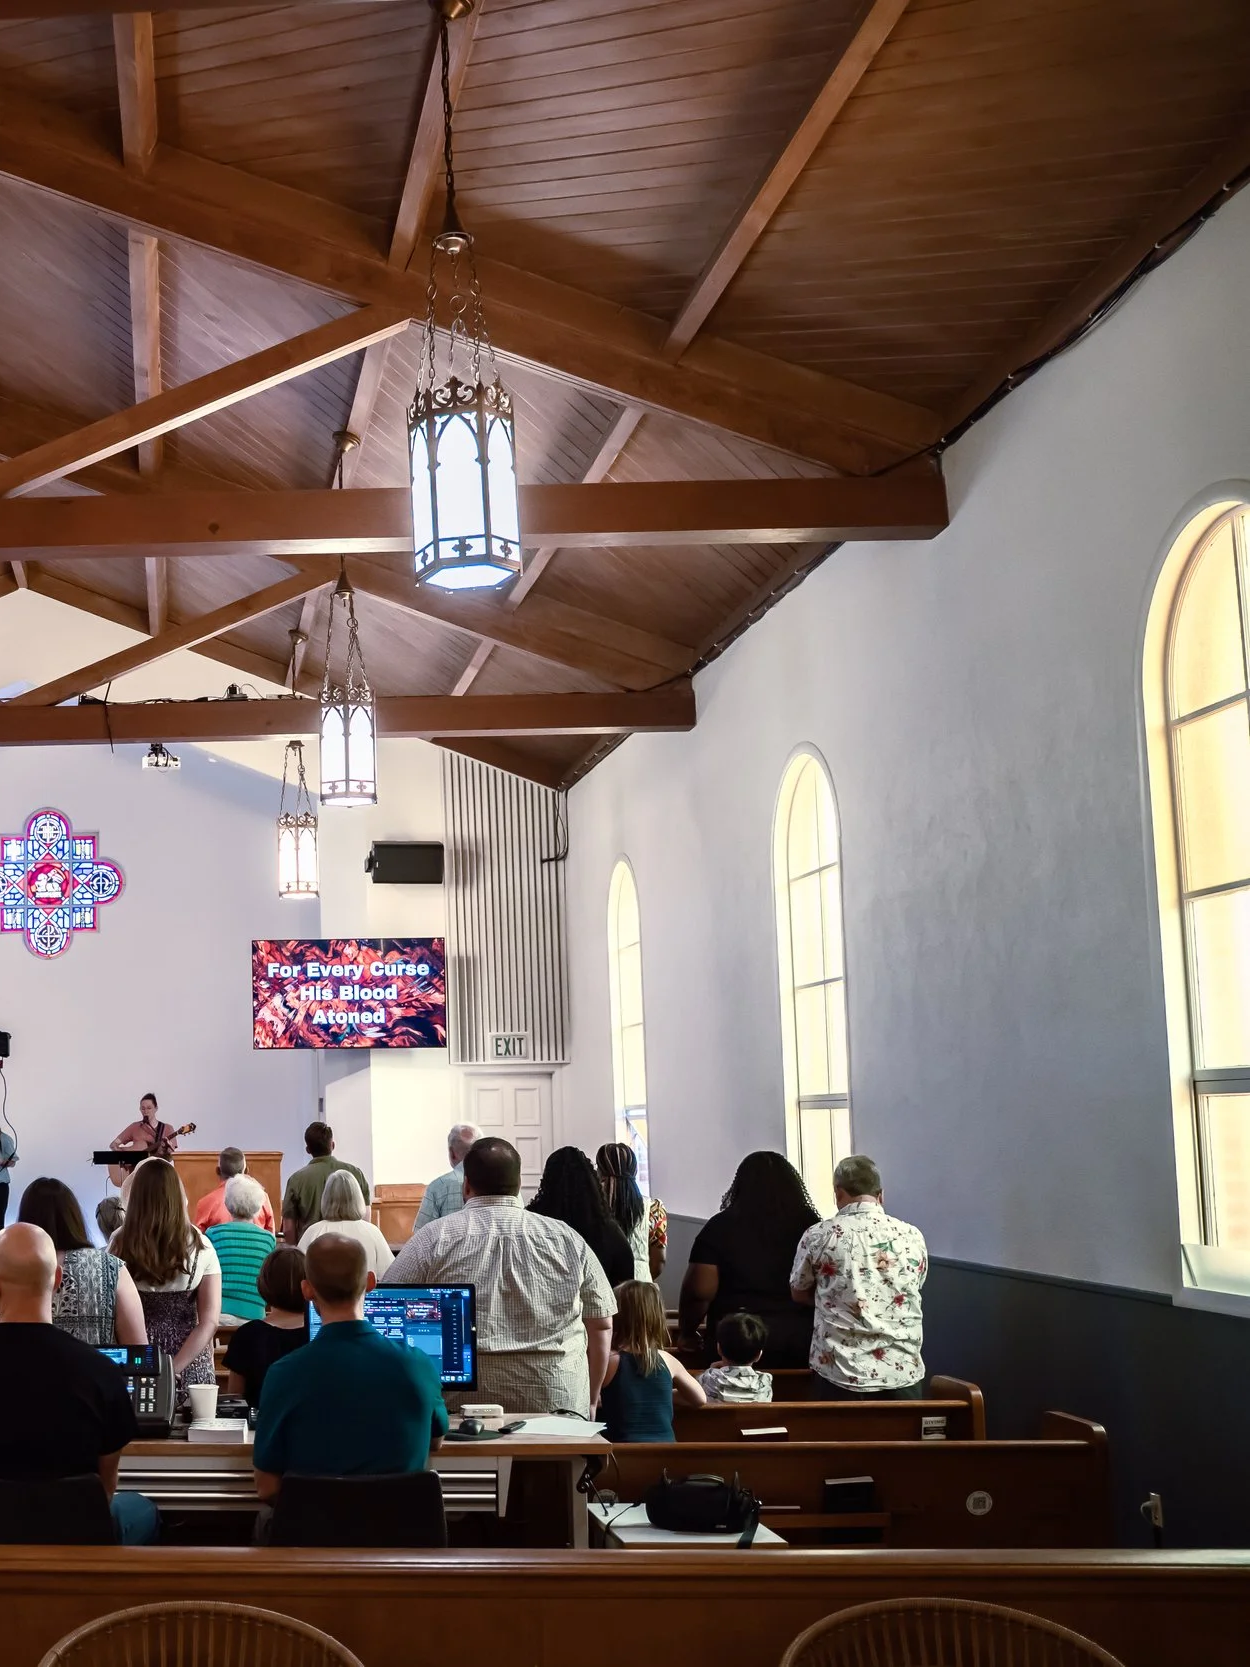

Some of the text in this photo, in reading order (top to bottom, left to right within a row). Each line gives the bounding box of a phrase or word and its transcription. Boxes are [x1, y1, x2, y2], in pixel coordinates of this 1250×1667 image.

[267, 962, 429, 979] For Every Curse
[301, 985, 397, 1000] His Blood
[312, 1009, 385, 1024] Atoned
[495, 1037, 524, 1056] EXIT
